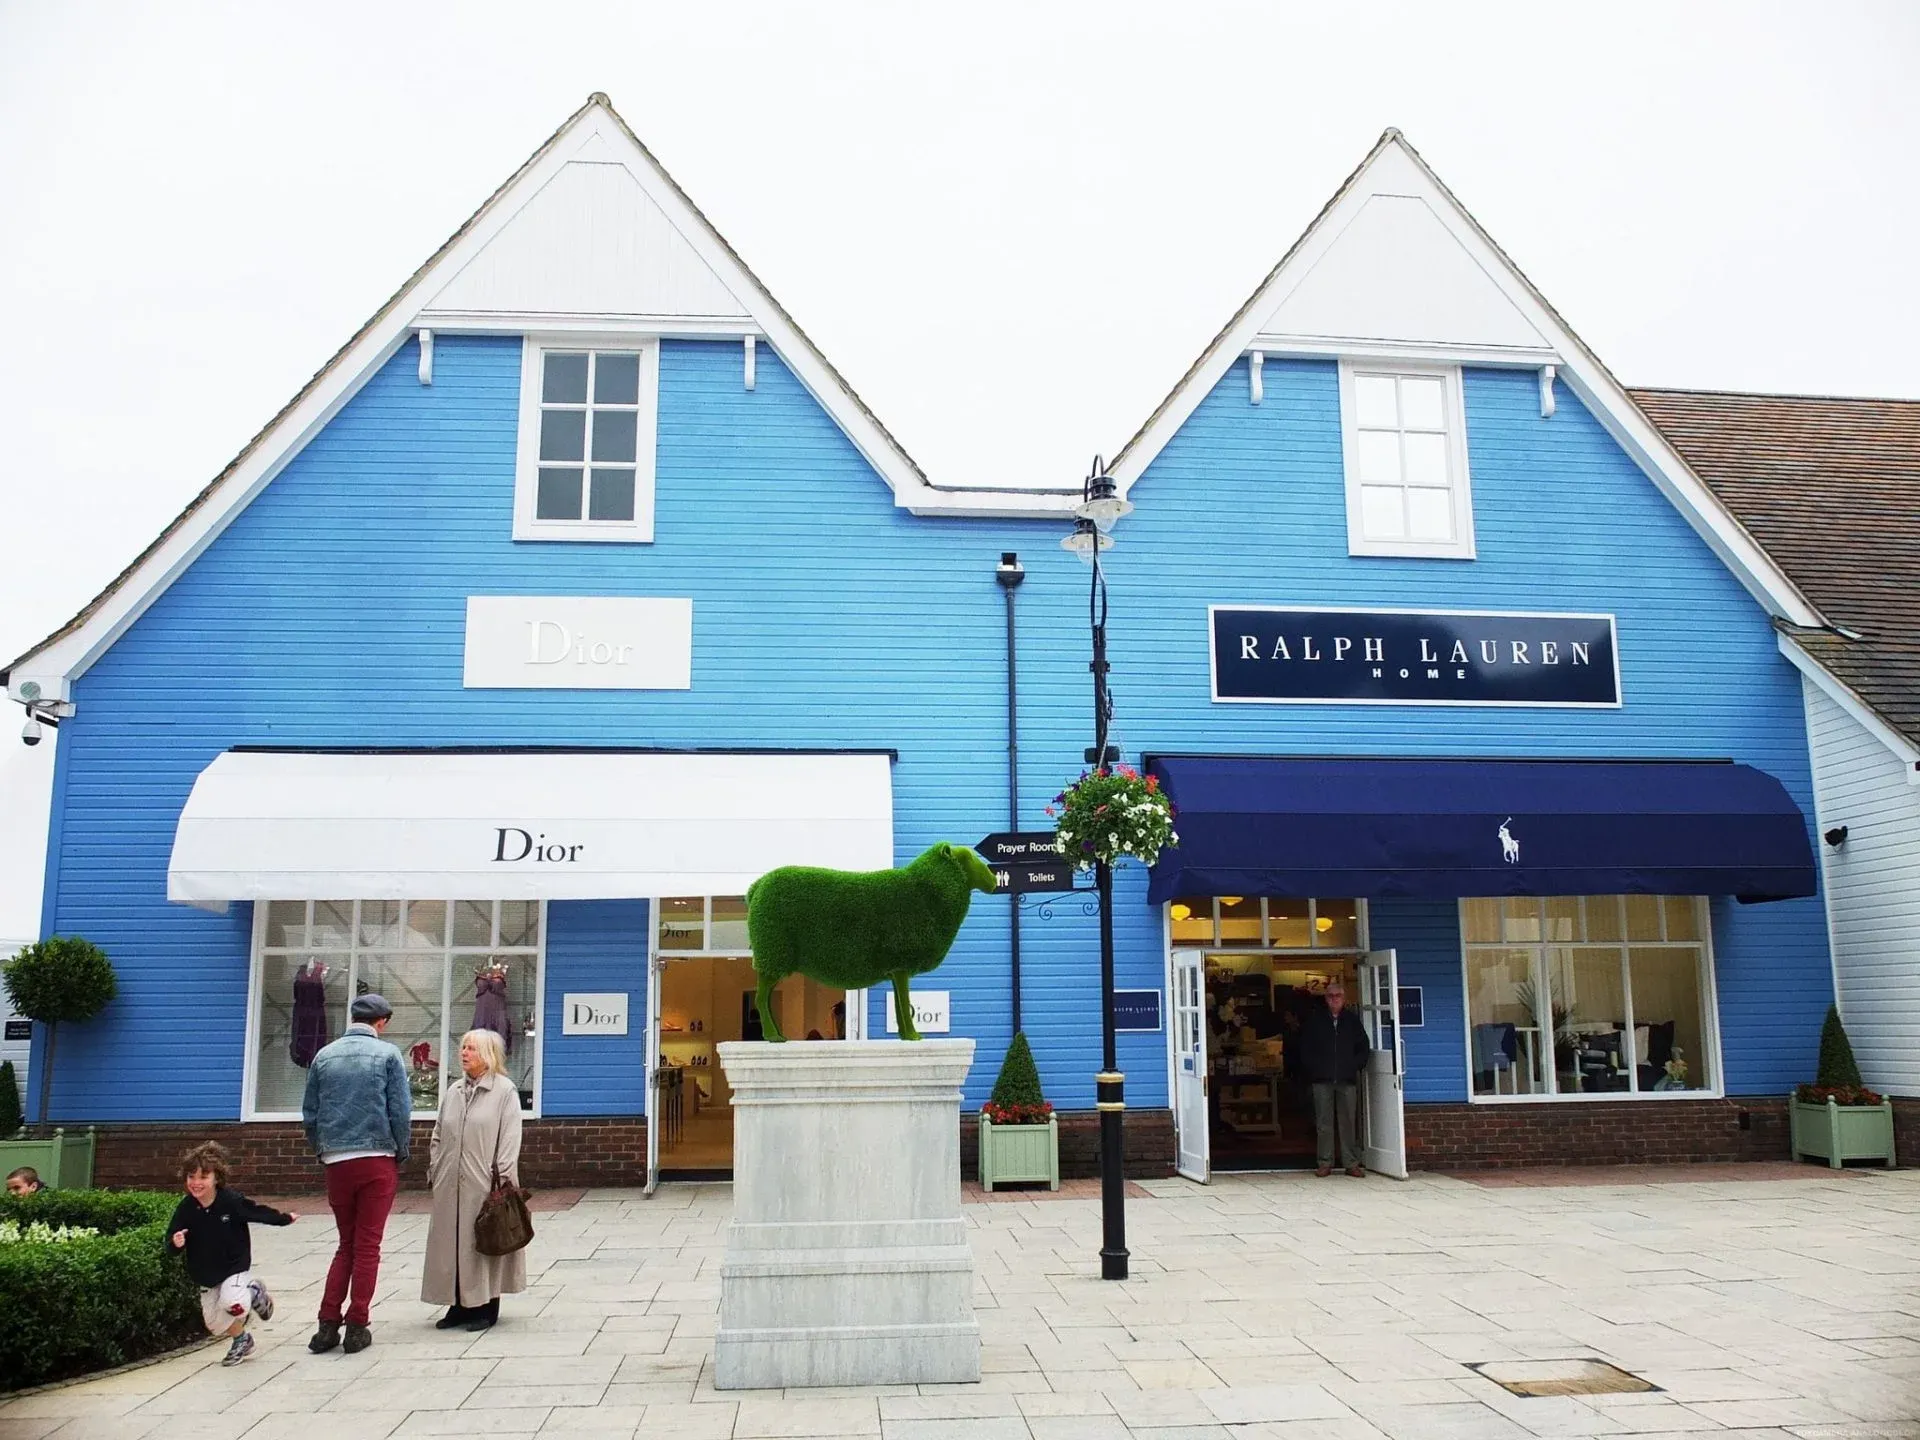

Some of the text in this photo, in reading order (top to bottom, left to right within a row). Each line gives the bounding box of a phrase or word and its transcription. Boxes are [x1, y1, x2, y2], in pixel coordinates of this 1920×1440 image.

[524, 619, 633, 666] Dior
[1239, 634, 1591, 666] RALPH LAUREN
[1371, 667, 1466, 679] HOME
[491, 827, 584, 863] Dior
[997, 843, 1026, 855] Prayer
[1028, 872, 1055, 883] Toilets
[572, 1003, 621, 1026] Dior
